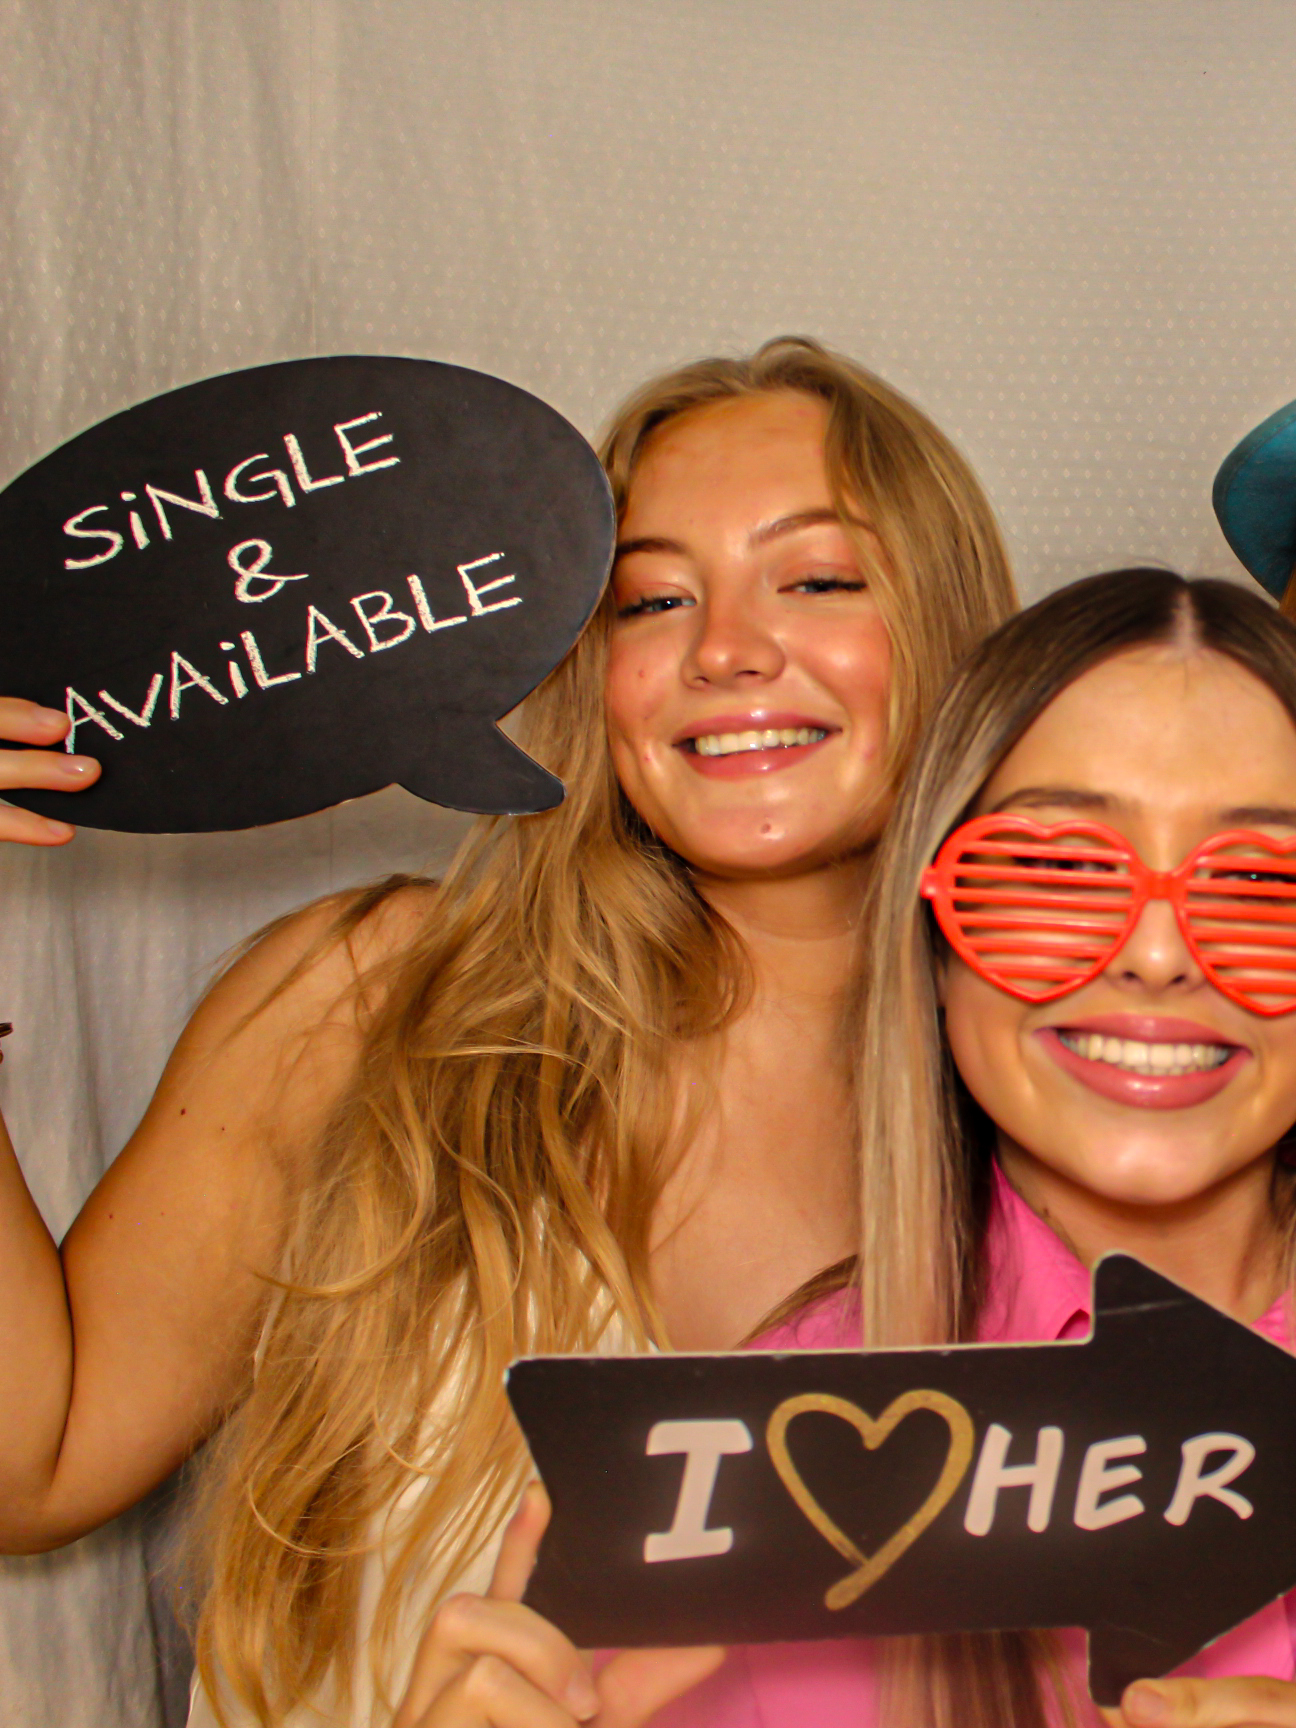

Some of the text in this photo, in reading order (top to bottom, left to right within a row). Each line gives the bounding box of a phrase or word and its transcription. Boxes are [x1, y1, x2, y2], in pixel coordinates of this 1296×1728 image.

[227, 538, 309, 603] &
[643, 1418, 1257, 1563] I HER
